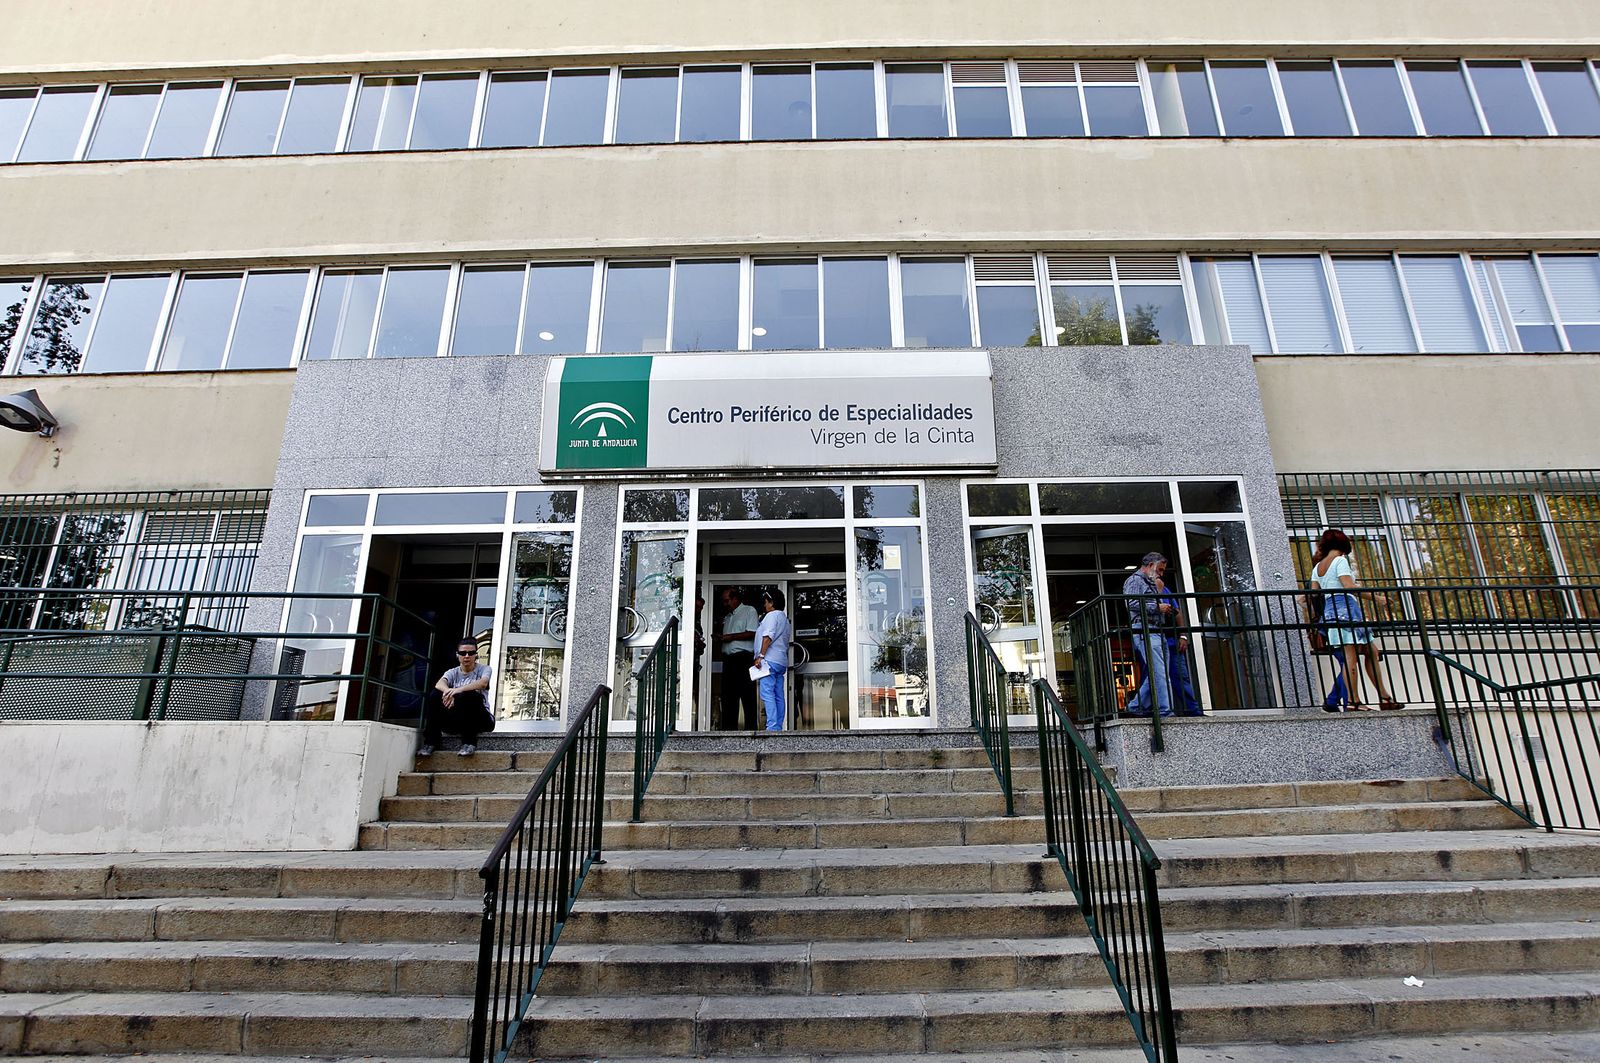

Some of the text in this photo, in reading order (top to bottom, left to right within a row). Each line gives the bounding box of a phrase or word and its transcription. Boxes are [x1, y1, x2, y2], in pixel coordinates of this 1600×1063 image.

[667, 403, 973, 425] Centro Periférico de Especialidades
[568, 439, 590, 448] JUNTA
[592, 439, 600, 448] DE
[810, 426, 975, 449] Virgen de la Cinta
